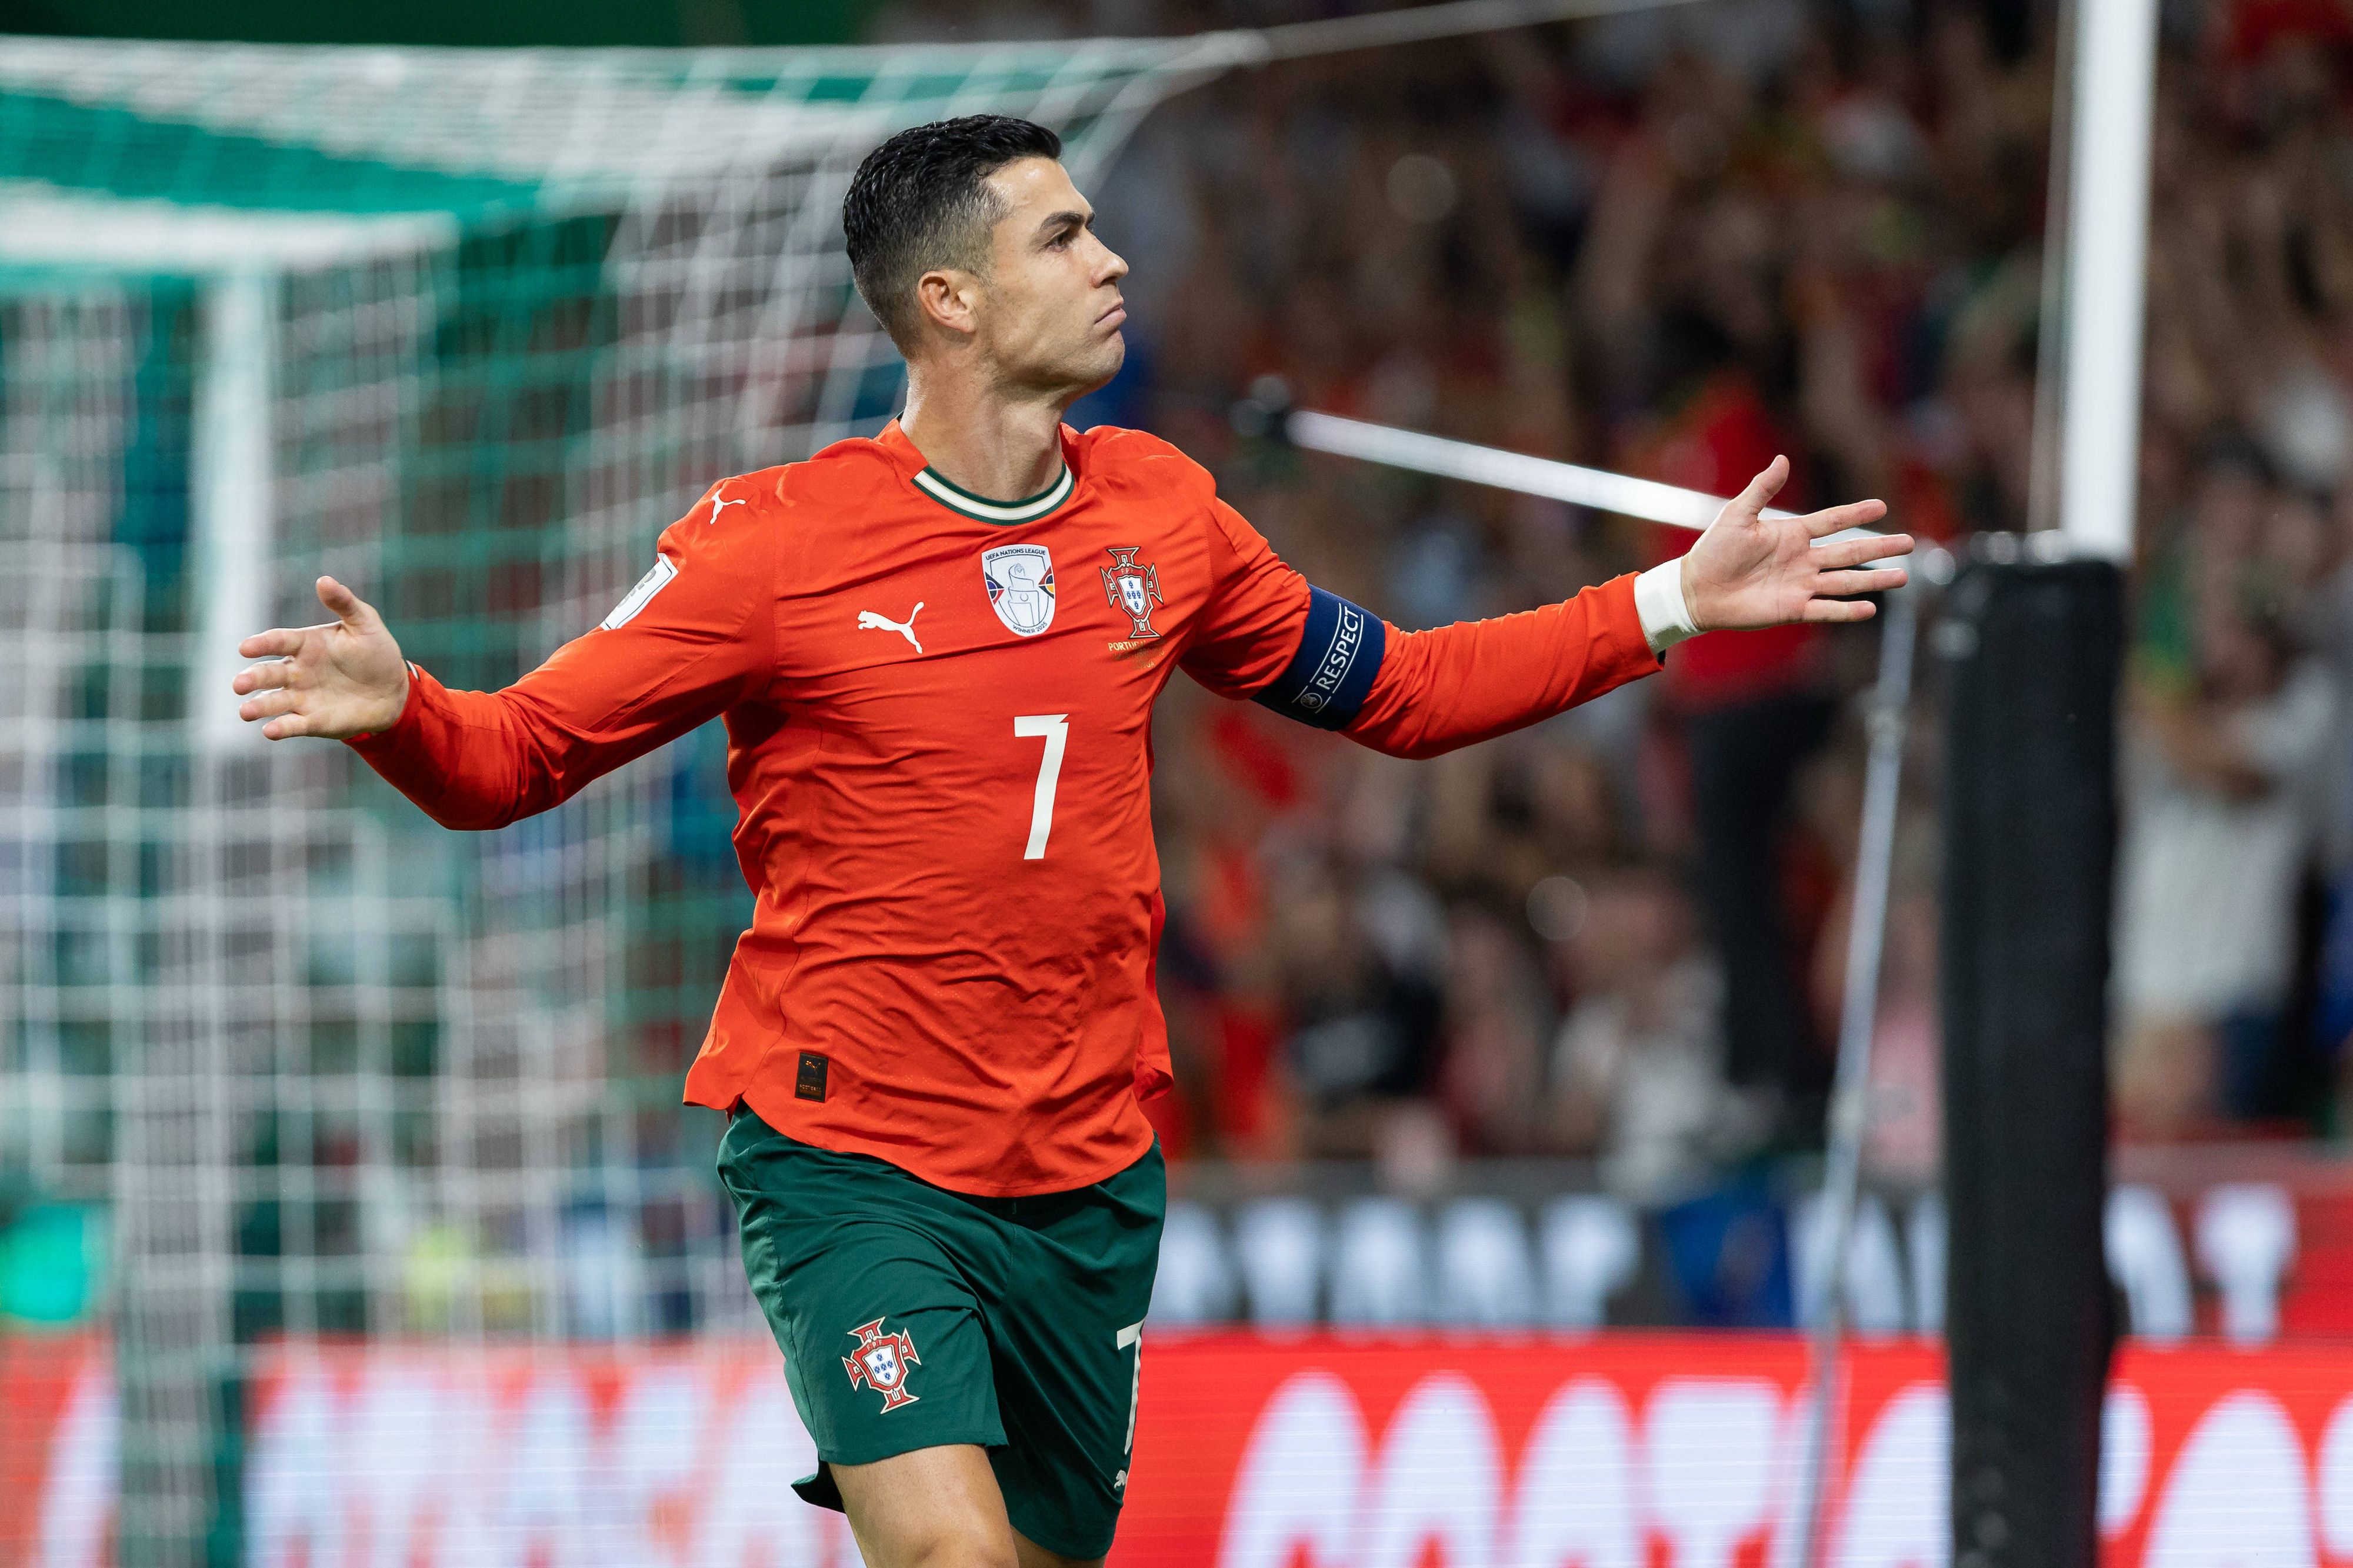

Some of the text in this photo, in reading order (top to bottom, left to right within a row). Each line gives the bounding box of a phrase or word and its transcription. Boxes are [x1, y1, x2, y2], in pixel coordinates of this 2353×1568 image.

[985, 552, 999, 561] UEFA
[1013, 621, 1047, 633] WINNER 2025
[1108, 640, 1146, 652] PORTU
[1316, 605, 1359, 690] RESPECT
[1014, 713, 1069, 860] 7
